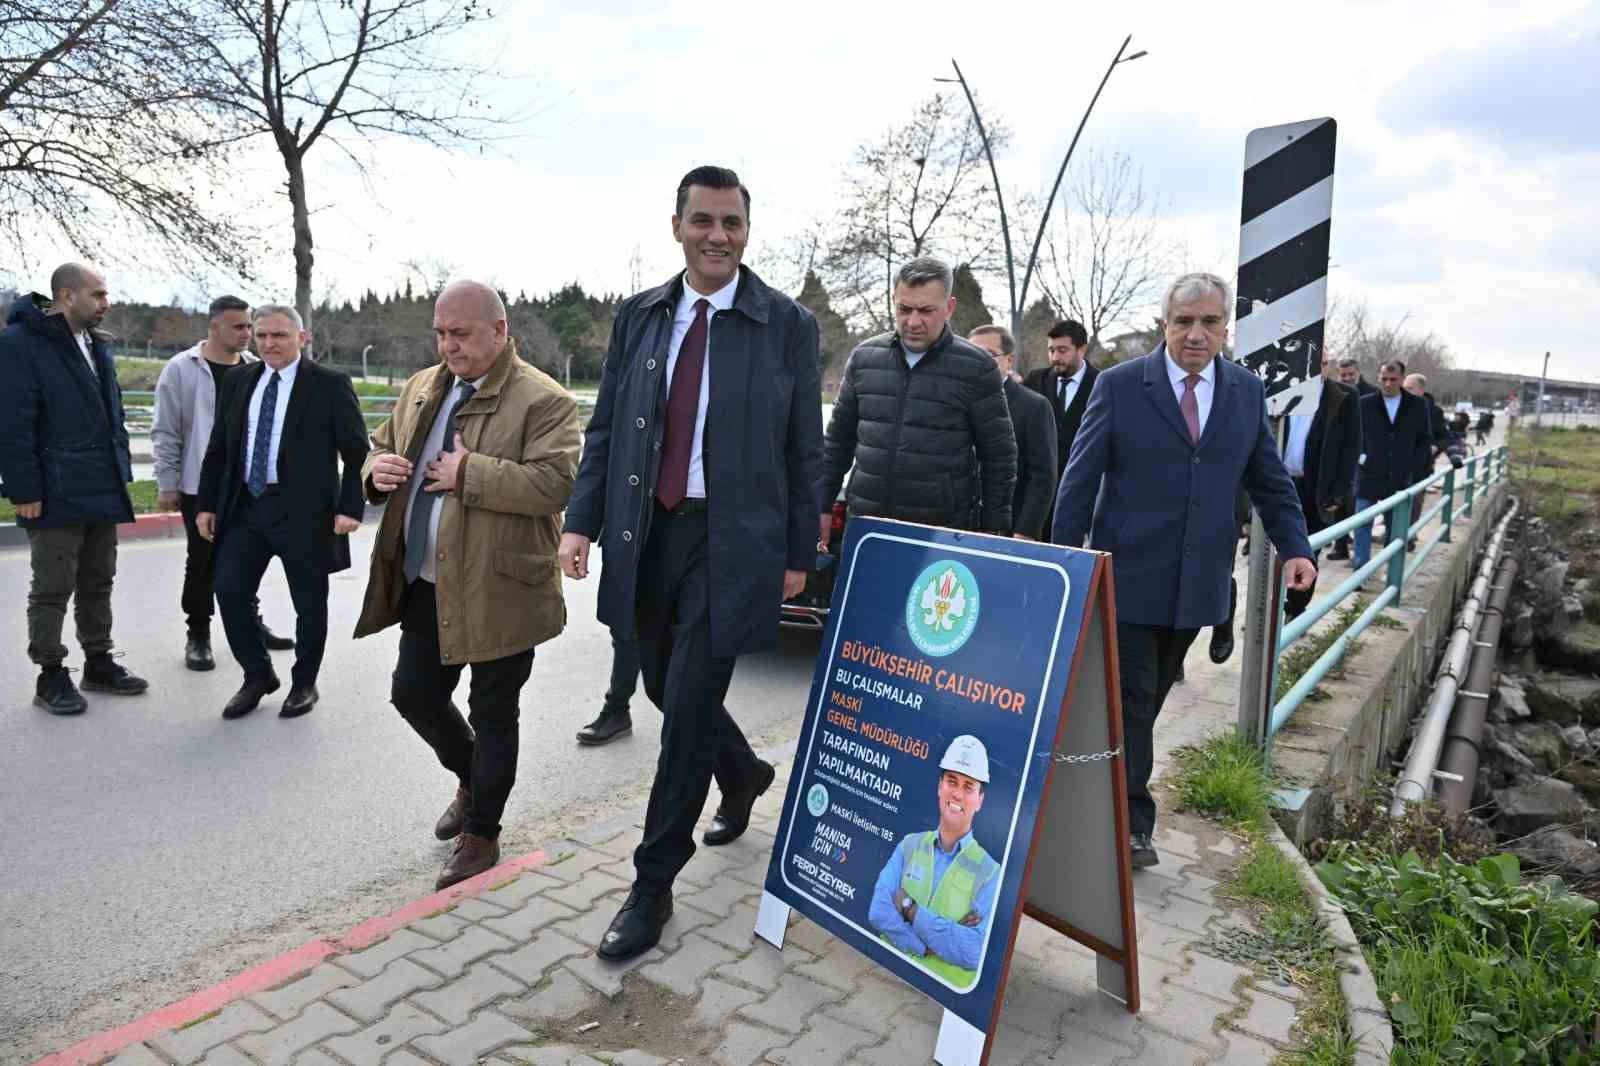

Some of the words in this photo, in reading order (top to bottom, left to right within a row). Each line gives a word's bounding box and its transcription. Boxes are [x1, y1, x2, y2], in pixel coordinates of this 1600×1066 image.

[836, 668, 850, 684] BU
[852, 674, 924, 711] ÇALIŞMALAR
[842, 641, 932, 685] BÜYÜKŞEHİR
[935, 669, 1026, 714] ÇALIŞIYOR
[831, 691, 863, 713] MASKİ
[822, 730, 890, 771] TARAFINDAN
[827, 710, 858, 733] GENEL
[860, 720, 929, 760] MÜDÜRLÜĞÜ
[817, 751, 903, 800] YAPILMAKTADIR
[814, 822, 852, 851] MANİSA
[830, 803, 853, 822] MASKİ
[881, 828, 894, 842] 185
[811, 834, 833, 856] İÇİN
[792, 854, 819, 877] FERDİ
[818, 869, 856, 900] ZEYREK
